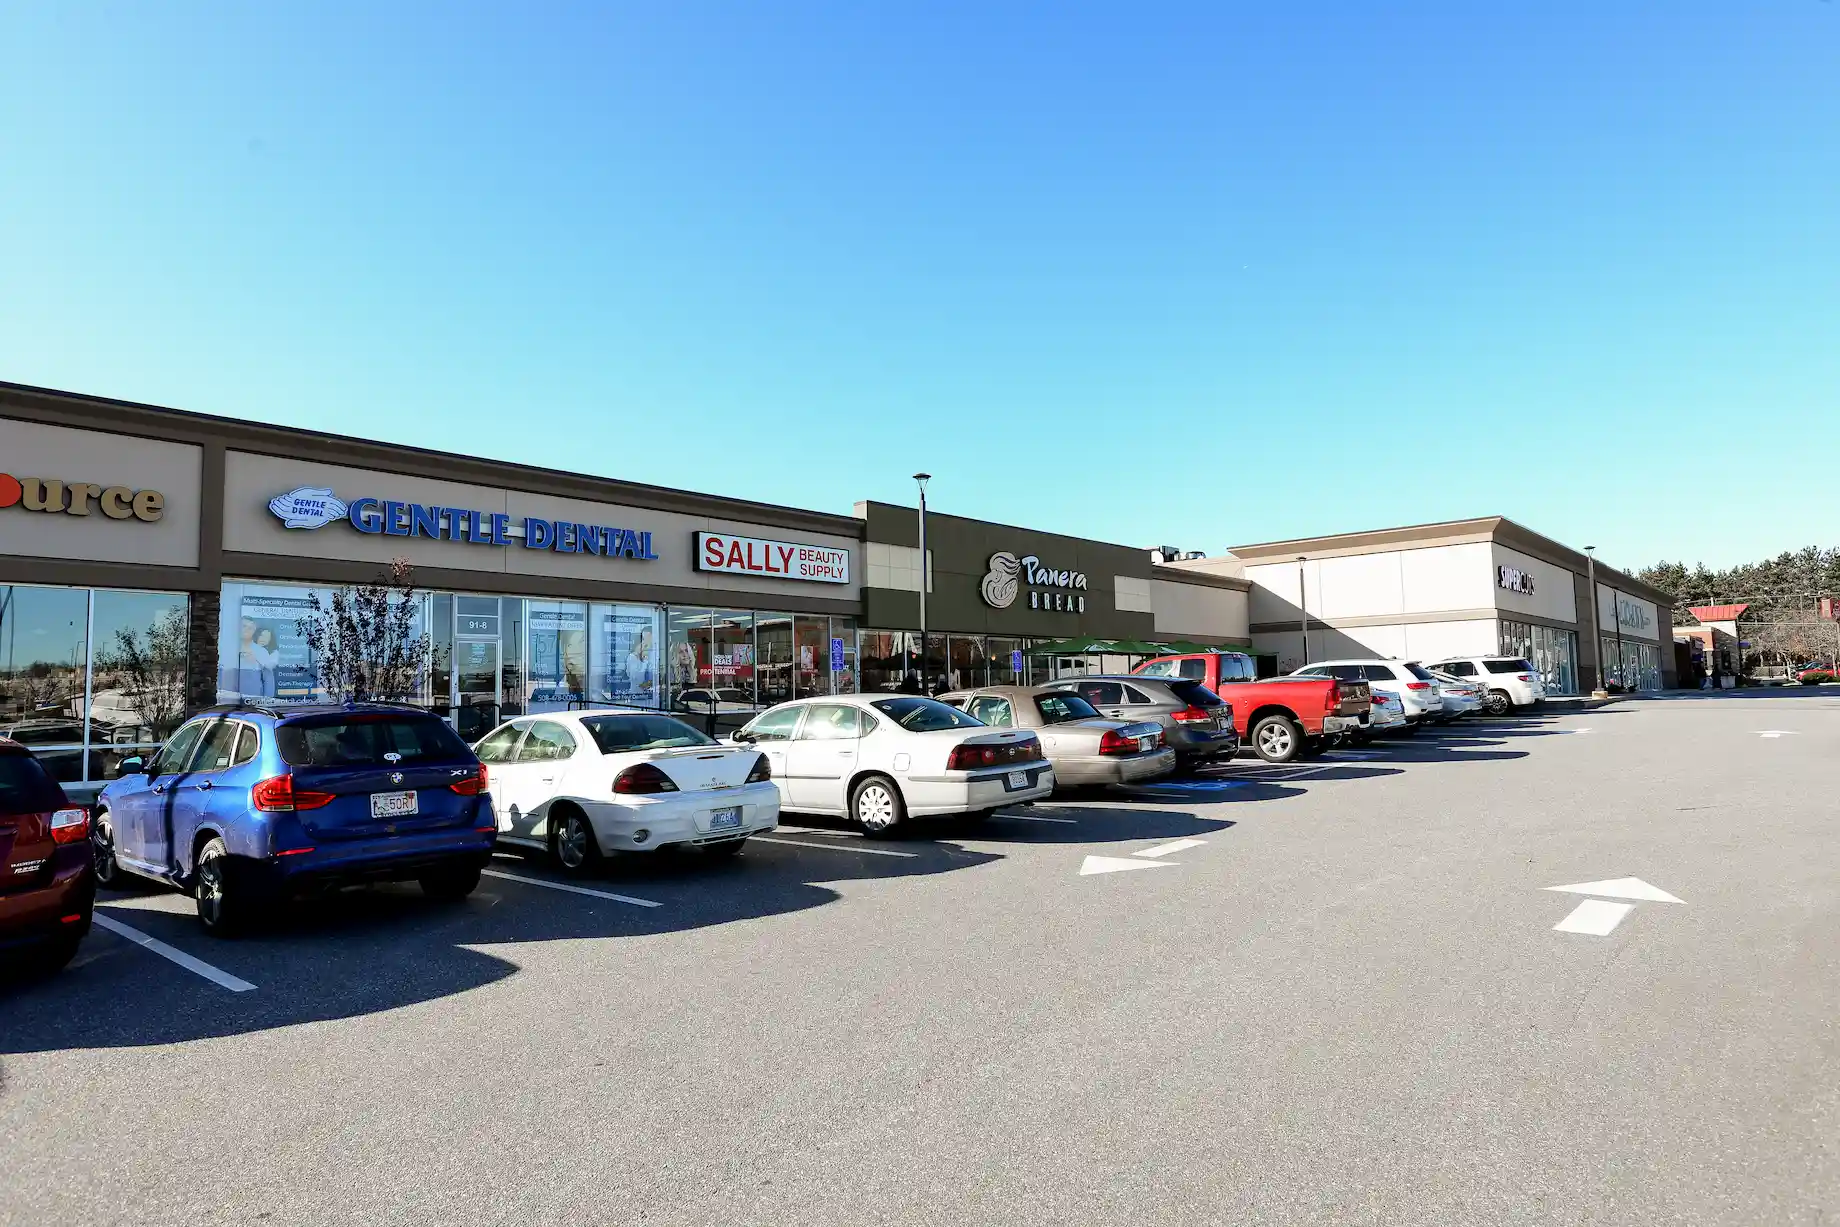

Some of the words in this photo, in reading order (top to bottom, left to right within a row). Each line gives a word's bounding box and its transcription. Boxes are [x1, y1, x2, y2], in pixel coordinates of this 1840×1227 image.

[292, 507, 324, 516] DENTAL
[294, 499, 327, 508] GENTLE
[350, 497, 512, 545] GENTLE
[524, 517, 659, 560] DENTAL
[705, 537, 795, 573] SALLY
[800, 549, 844, 565] BEAUTY
[800, 564, 844, 579] SUPPLY
[1021, 555, 1087, 591] Panera
[1499, 565, 1535, 596] SUPERCUTS
[1029, 591, 1085, 613] BREAD
[469, 620, 487, 629] 91-8
[450, 769, 468, 777] X1
